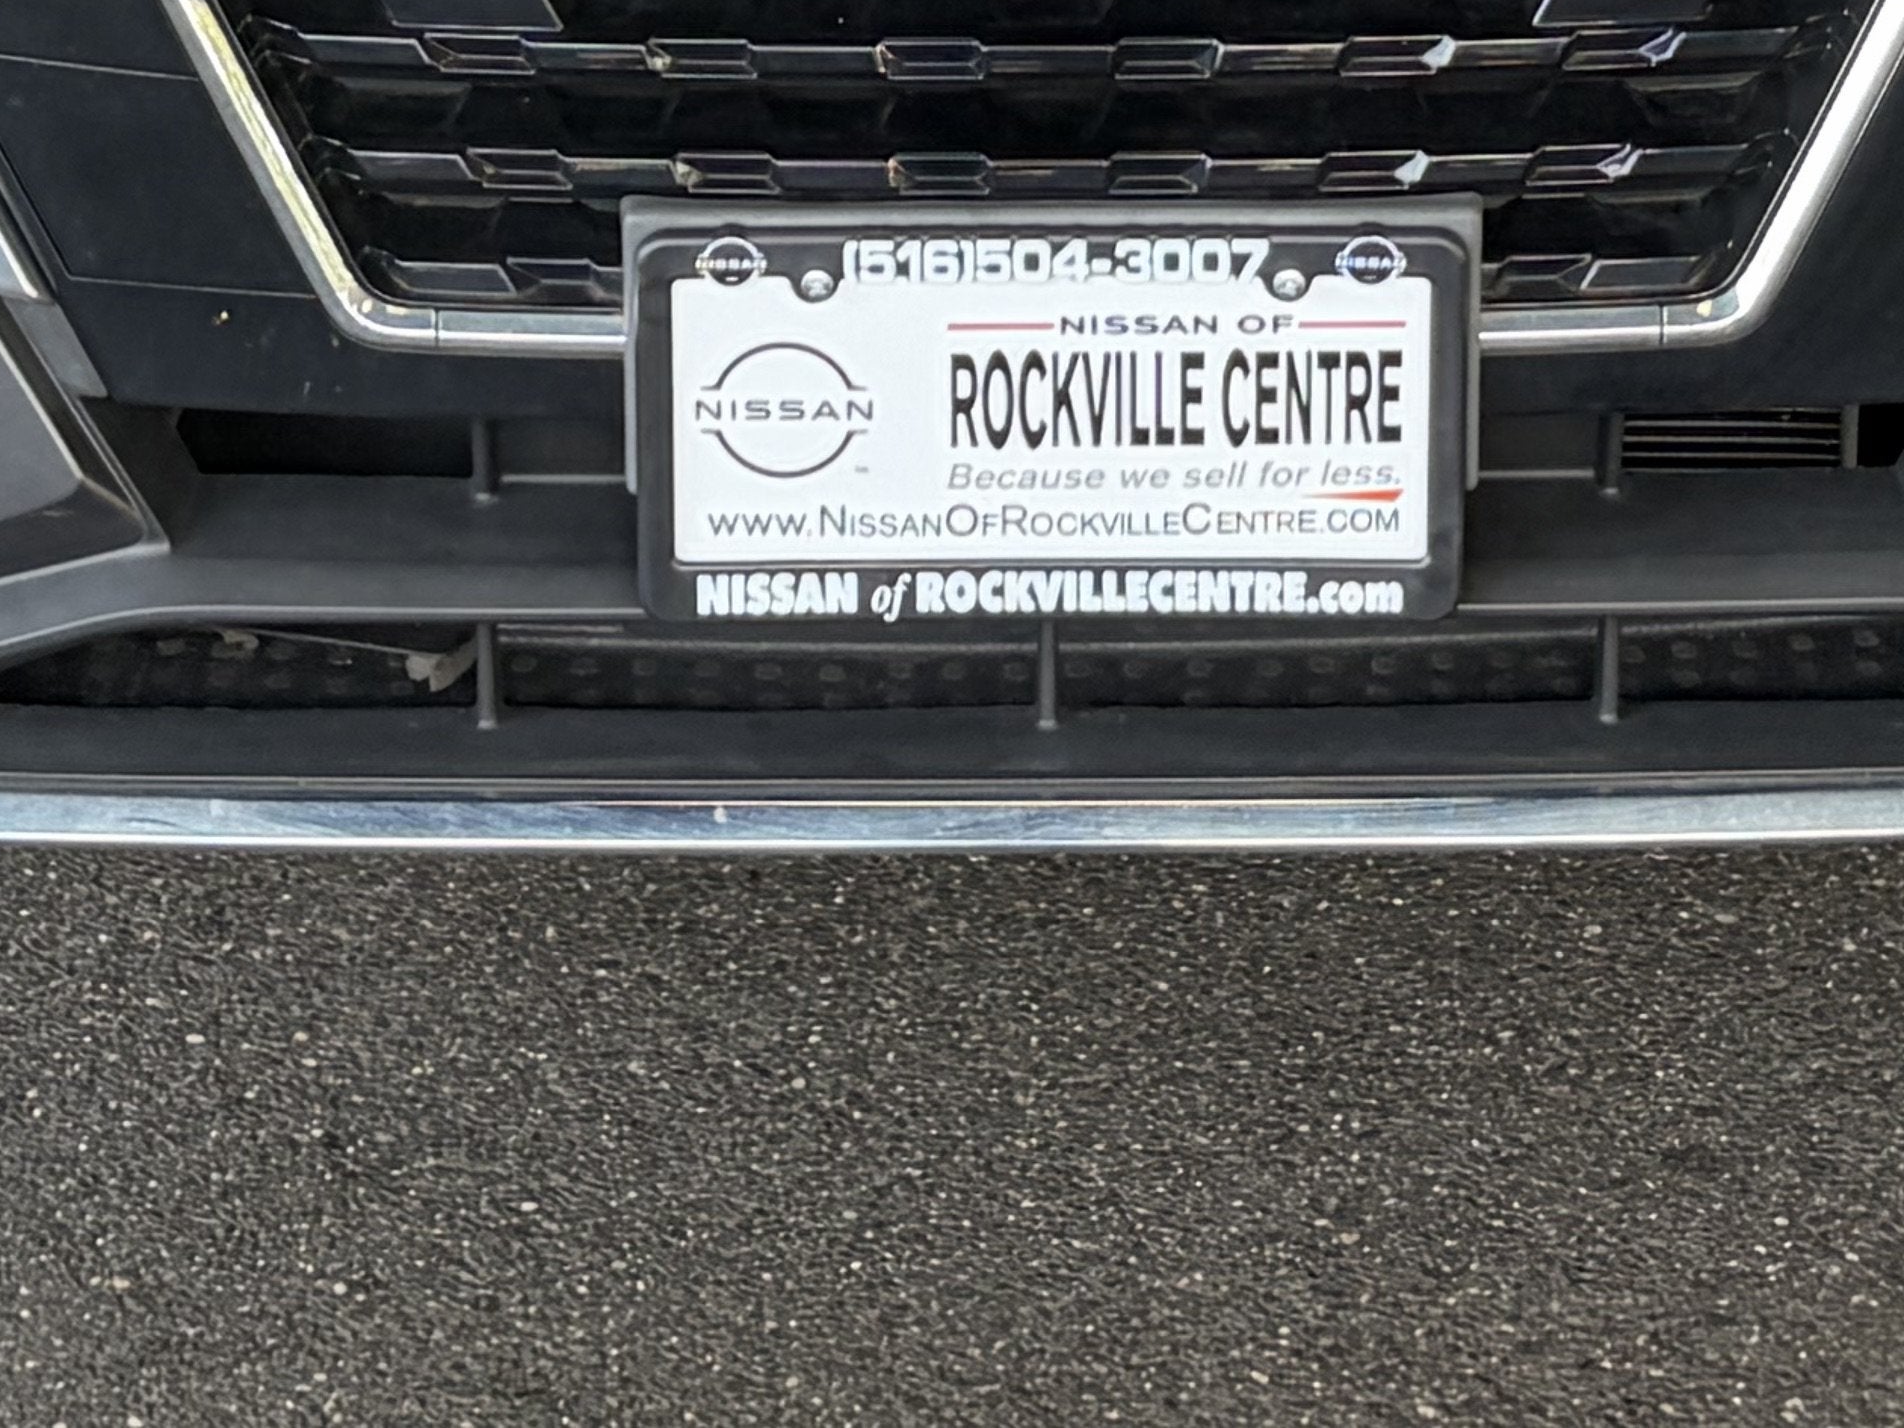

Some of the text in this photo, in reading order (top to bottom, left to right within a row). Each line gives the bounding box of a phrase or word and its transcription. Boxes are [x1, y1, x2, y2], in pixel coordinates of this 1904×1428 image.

[1060, 314, 1295, 336] NISSAN OF
[695, 399, 874, 421] NISSAN
[950, 347, 1403, 451] ROCKVILLE CENTRE
[947, 459, 1402, 491] Because we sell for less.
[696, 569, 1404, 624] NISSAN of ROCKVILLECENTRE.com
